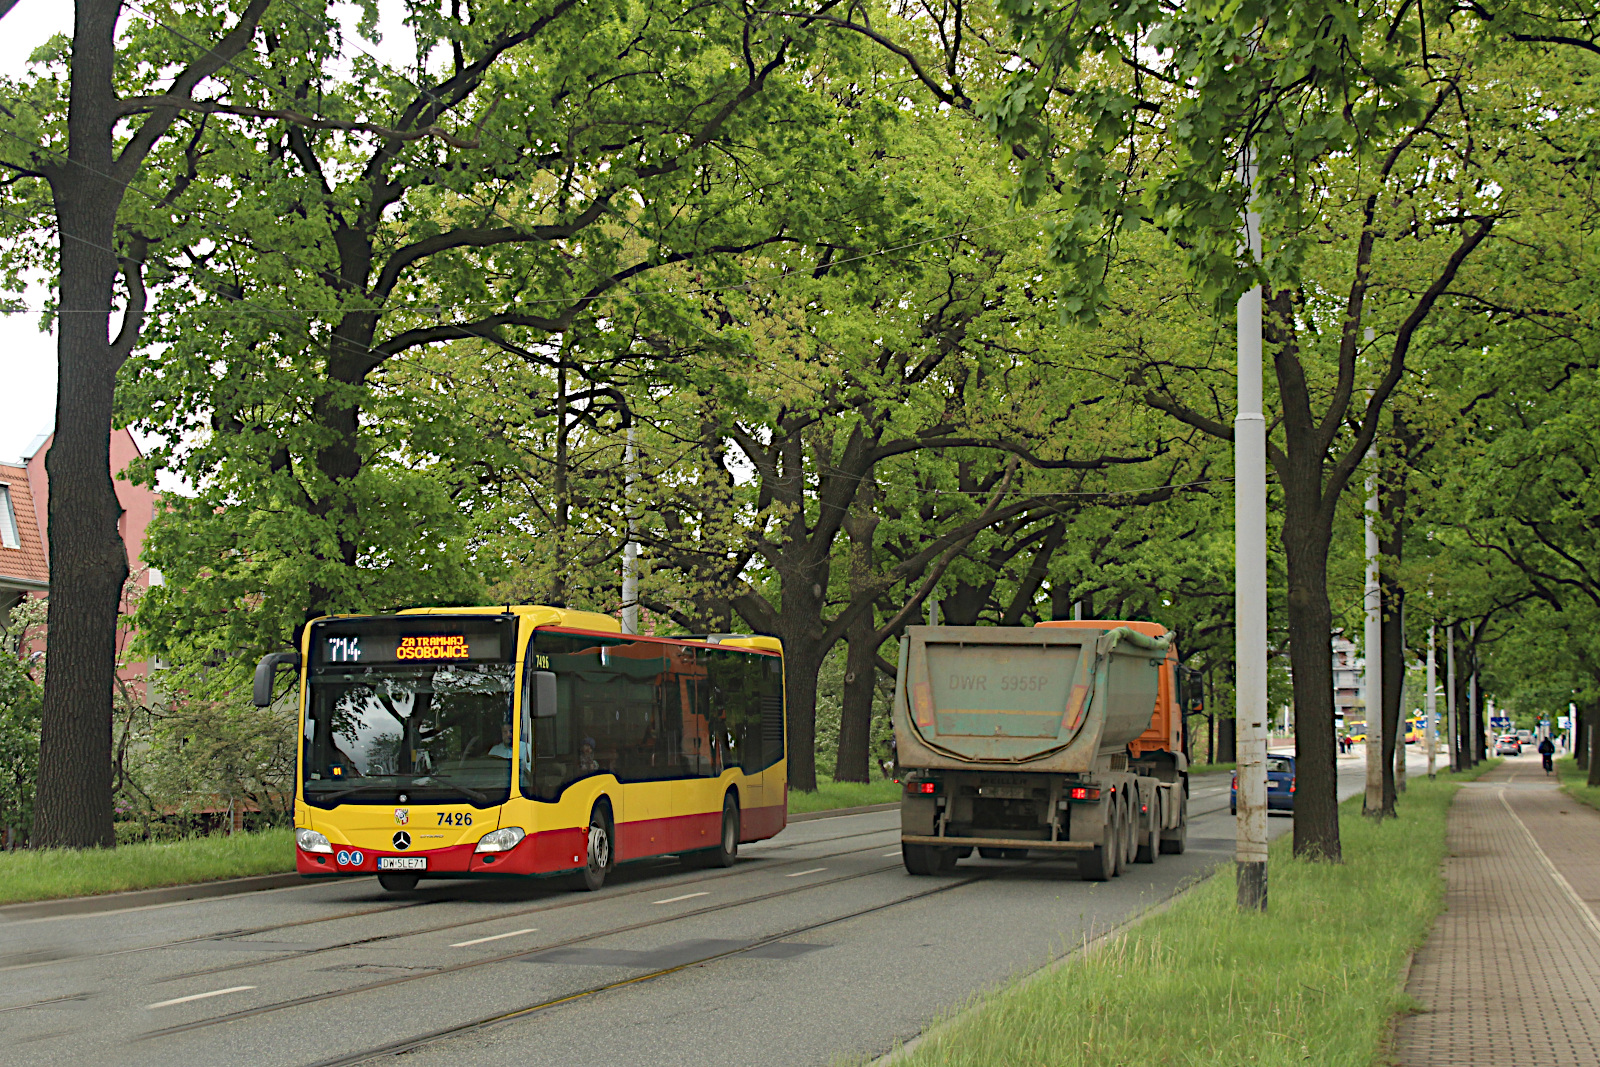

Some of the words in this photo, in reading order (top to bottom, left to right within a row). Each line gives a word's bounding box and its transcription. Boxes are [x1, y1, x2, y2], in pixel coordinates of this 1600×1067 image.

[401, 637, 416, 647] ZA
[416, 636, 464, 646] TRAMWAJ
[328, 637, 361, 662] 714
[396, 644, 469, 660] OSOBOWICE
[535, 654, 550, 669] 7426
[949, 674, 987, 691] DWR
[1000, 675, 1048, 692] 5955P
[436, 812, 473, 826] 7426
